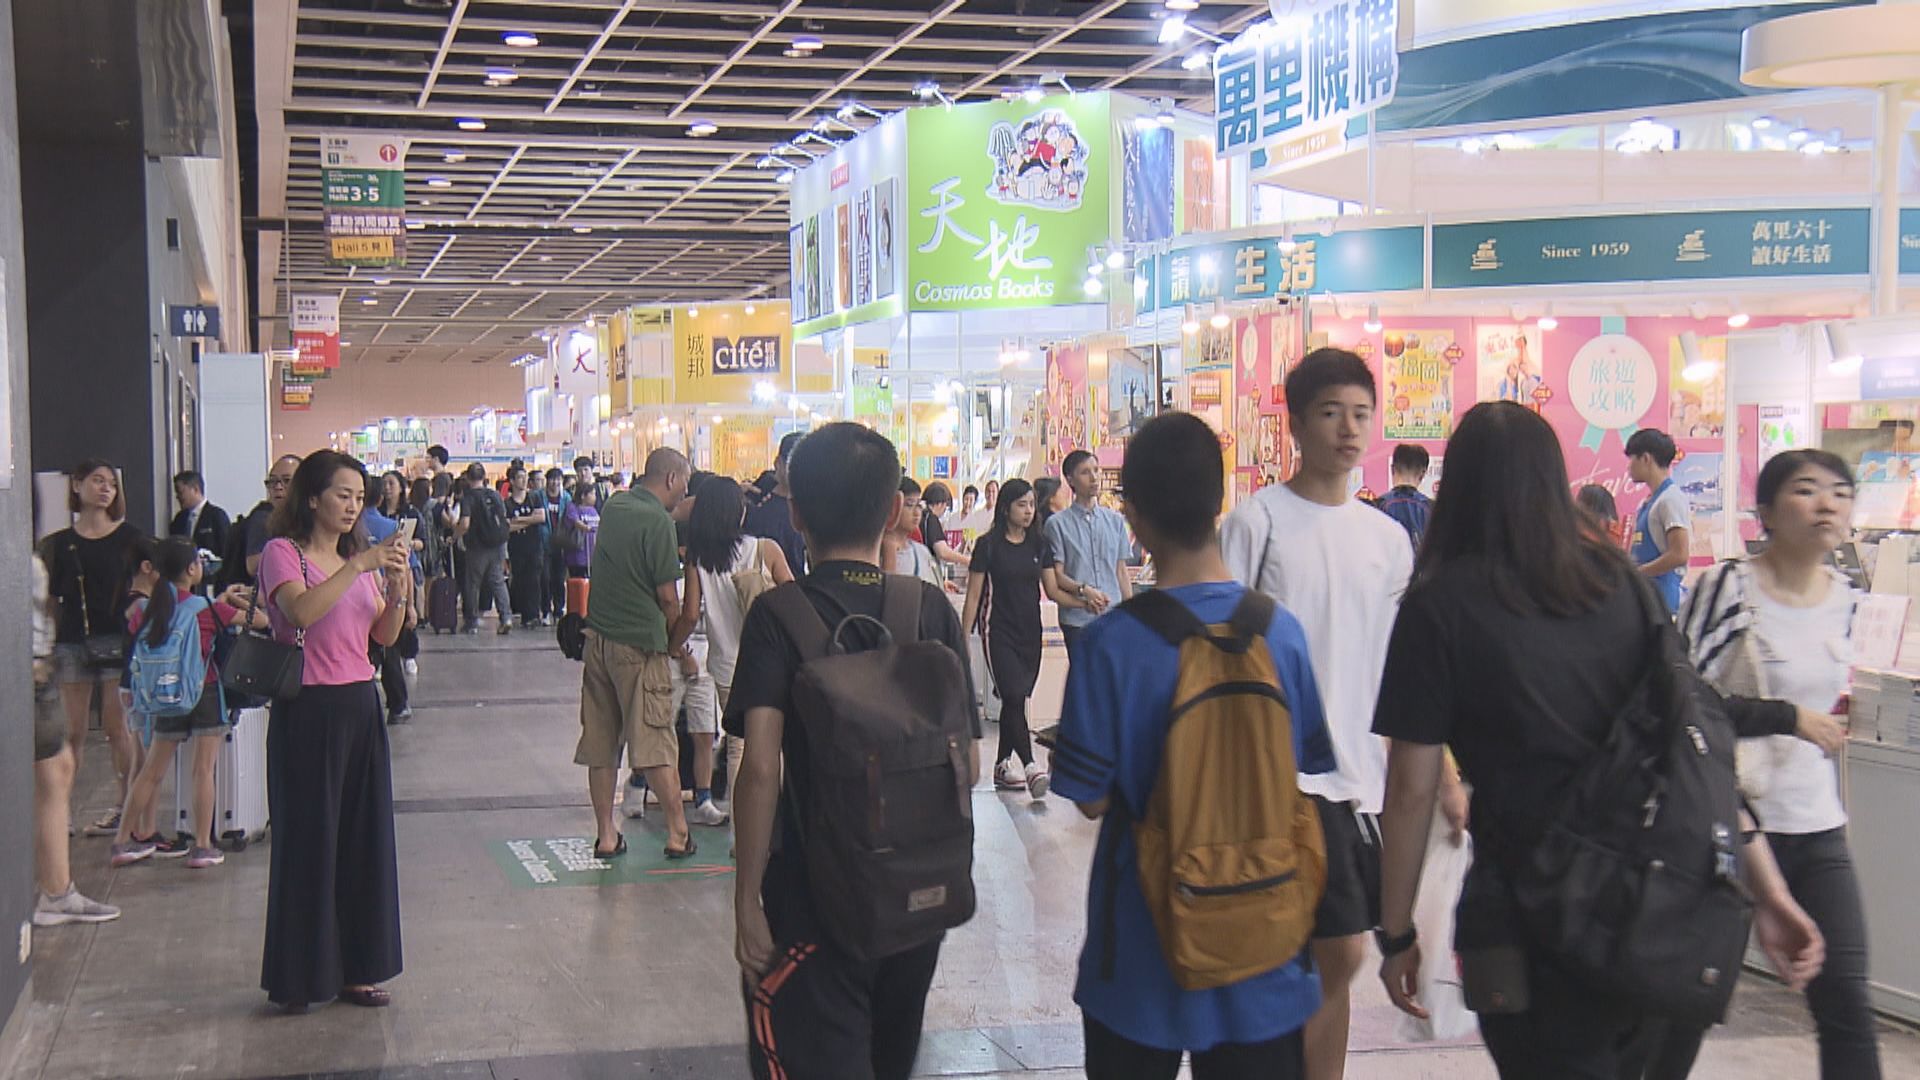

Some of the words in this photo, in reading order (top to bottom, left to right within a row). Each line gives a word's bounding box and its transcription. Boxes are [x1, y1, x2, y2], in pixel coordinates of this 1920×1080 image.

[1217, 1, 1394, 153] 萬里機構
[1283, 144, 1303, 159] Since
[1306, 134, 1327, 153] 1959
[918, 176, 1053, 279] 天地
[1751, 219, 1833, 242] 萬里六十
[337, 242, 358, 253] Hall
[1541, 244, 1581, 258] Since
[1591, 242, 1631, 257] 1959
[1751, 243, 1832, 266] 讀好生活
[915, 280, 992, 303] Cosmos
[998, 276, 1054, 299] Books
[687, 333, 705, 380] 城邦
[715, 340, 763, 369] cité
[1588, 358, 1637, 384] 旅遊
[1588, 389, 1637, 413] 攻略
